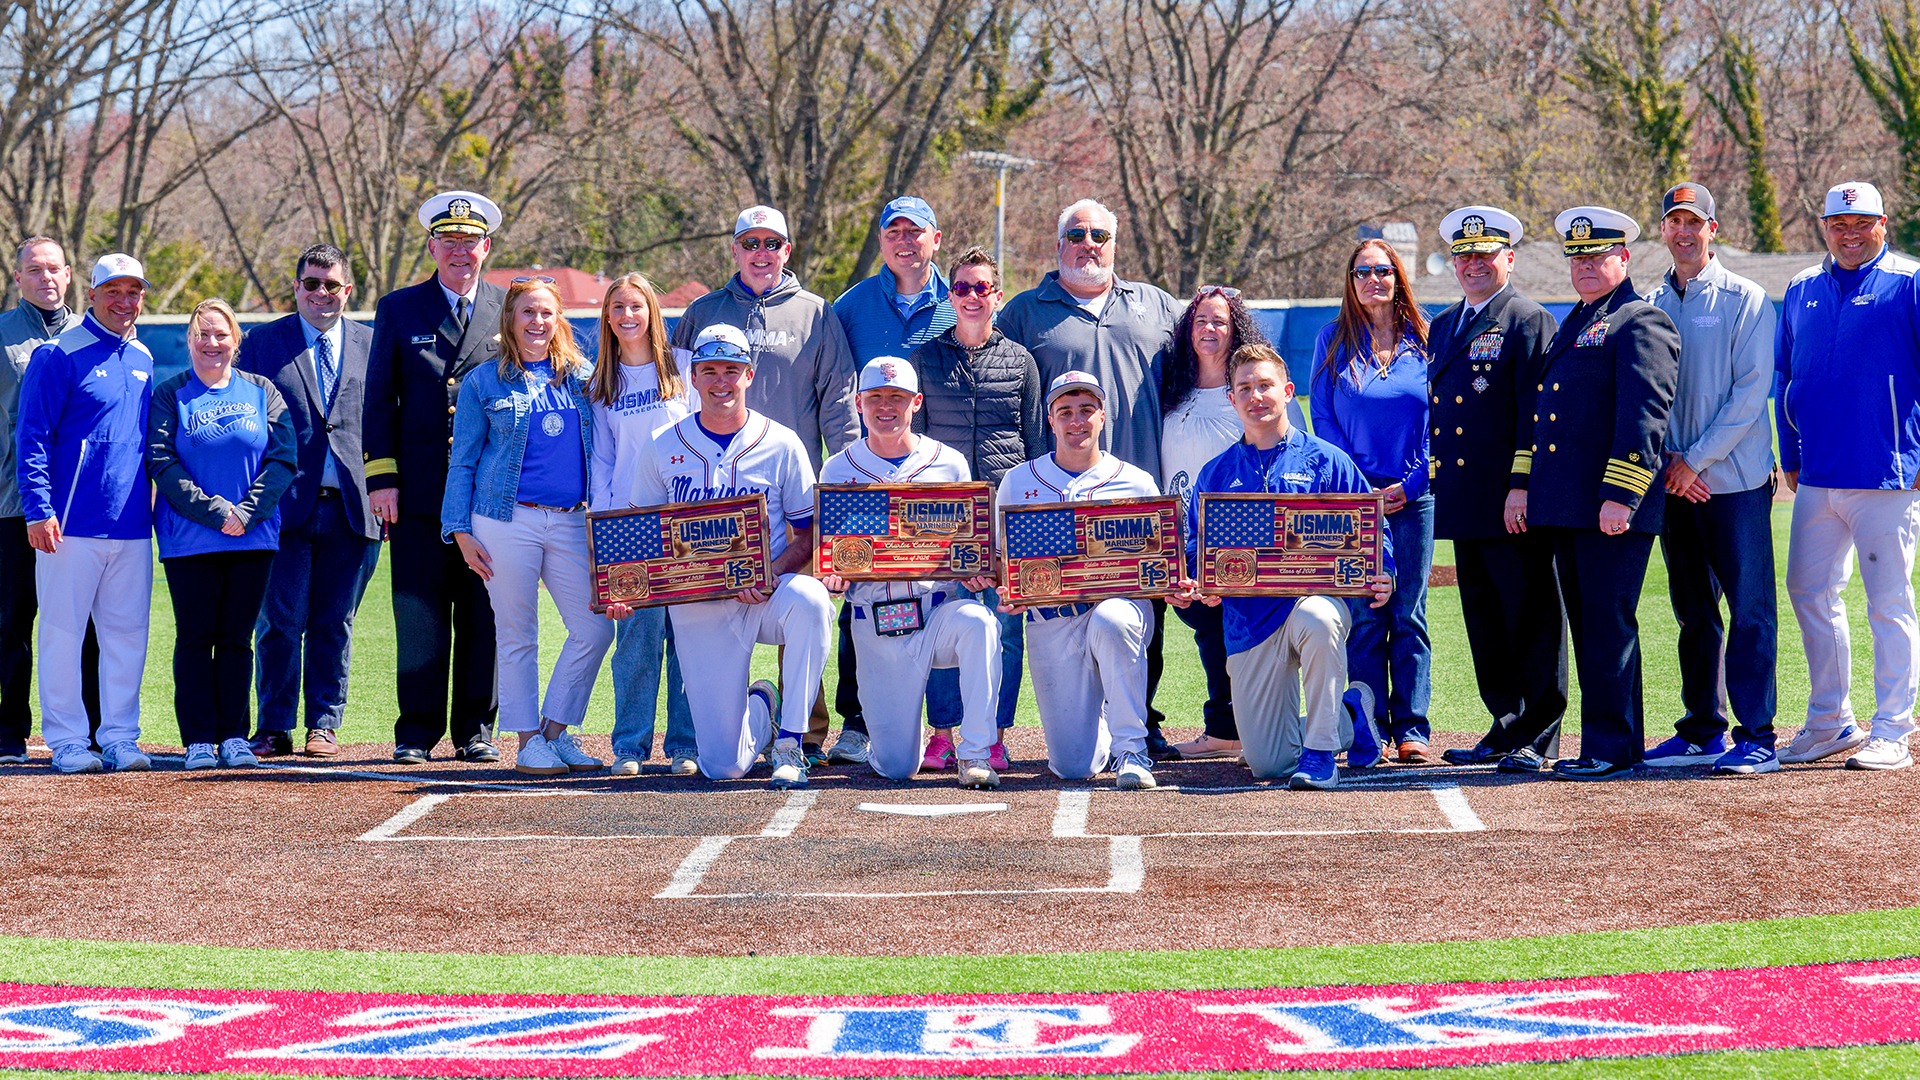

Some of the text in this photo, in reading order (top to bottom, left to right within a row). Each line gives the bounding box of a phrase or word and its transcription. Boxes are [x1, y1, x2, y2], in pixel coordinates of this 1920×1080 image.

[743, 328, 787, 346] MMA
[614, 387, 661, 412] USMM
[622, 402, 668, 417] BASEBALL
[185, 402, 258, 437] Mariners
[907, 502, 967, 523] USMMA
[679, 516, 739, 543] USMMA
[916, 521, 956, 530] MARINERS
[1093, 517, 1154, 541] USMMA
[1294, 513, 1353, 536] USMMA
[690, 537, 731, 549] MARINERS
[1104, 538, 1146, 548] MARINERS
[1302, 534, 1344, 543] MARINERS
